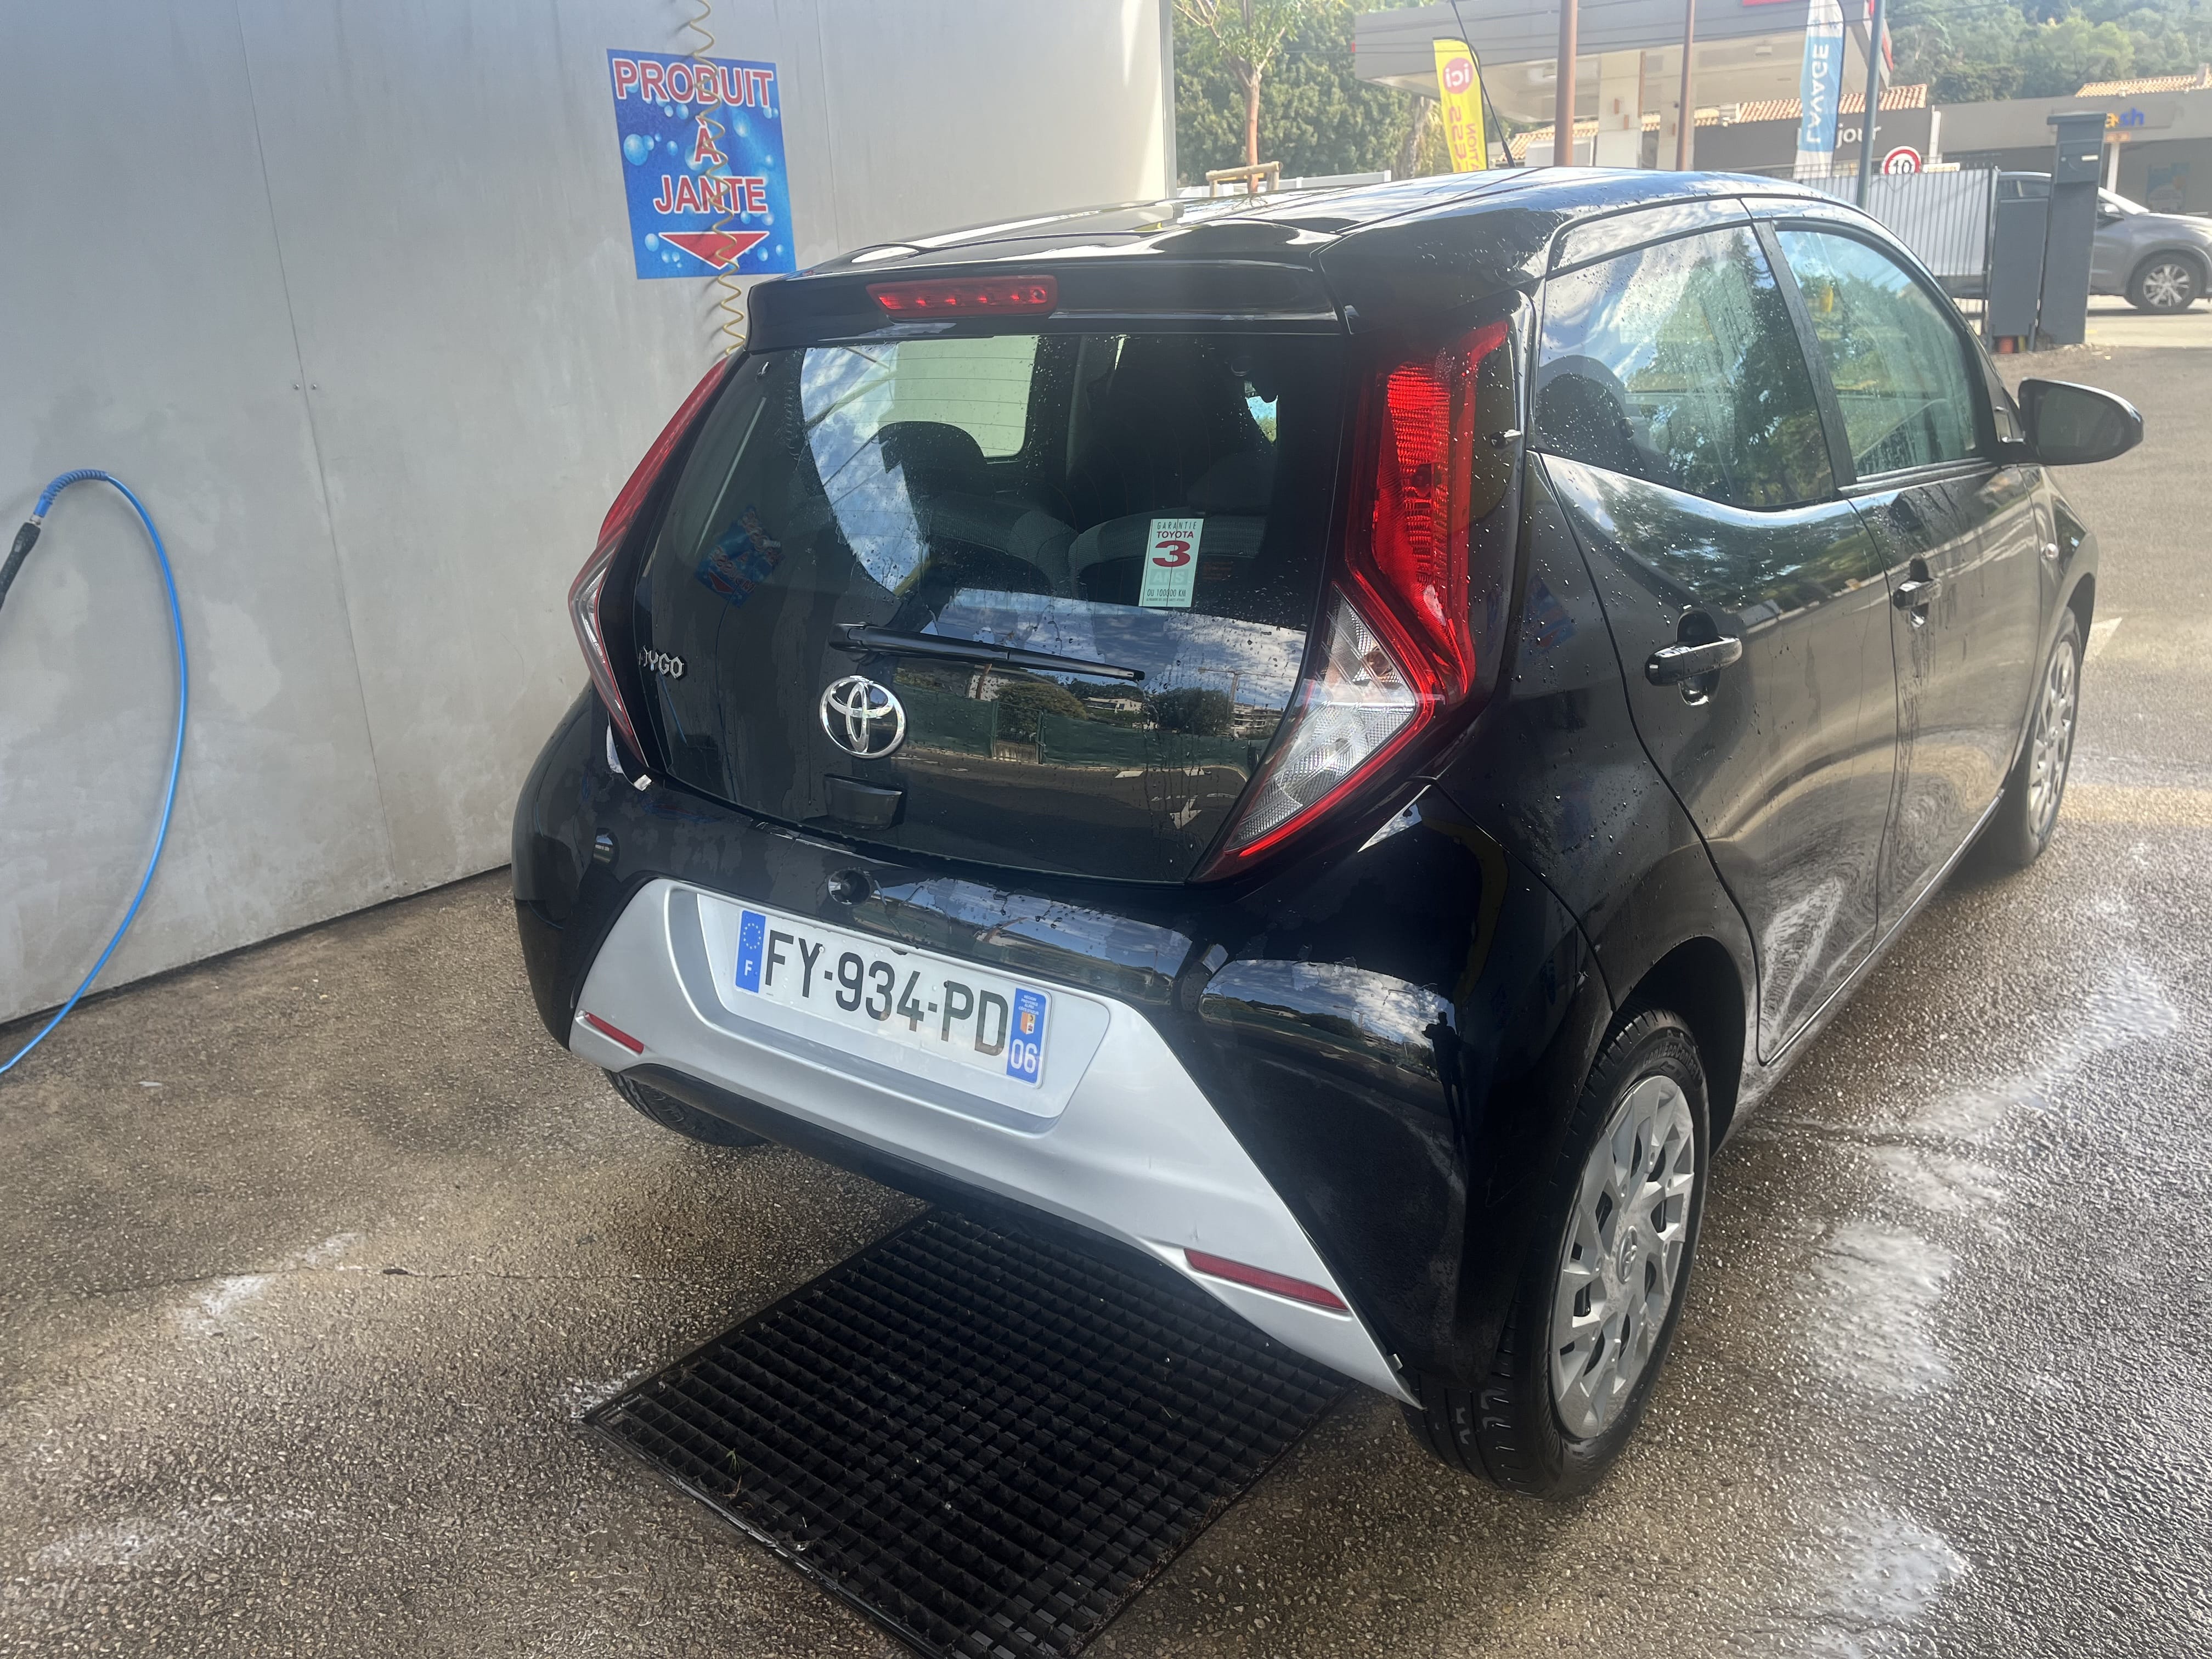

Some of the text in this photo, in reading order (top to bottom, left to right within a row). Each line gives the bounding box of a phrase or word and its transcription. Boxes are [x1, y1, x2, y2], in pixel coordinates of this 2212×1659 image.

[612, 58, 774, 108] PRODUIT
[694, 115, 721, 163] À
[1893, 160, 1912, 174] 10
[653, 174, 769, 215] JANTE
[1156, 531, 1194, 539] TOYOTA
[1157, 521, 1197, 530] GARANTIE
[1152, 540, 1191, 568] 3
[1153, 571, 1186, 583] ANS
[1147, 589, 1186, 597] OU 100000 KM
[744, 960, 753, 977] F
[765, 929, 1008, 1056] FY-934-PD
[1011, 1039, 1038, 1074] 06
